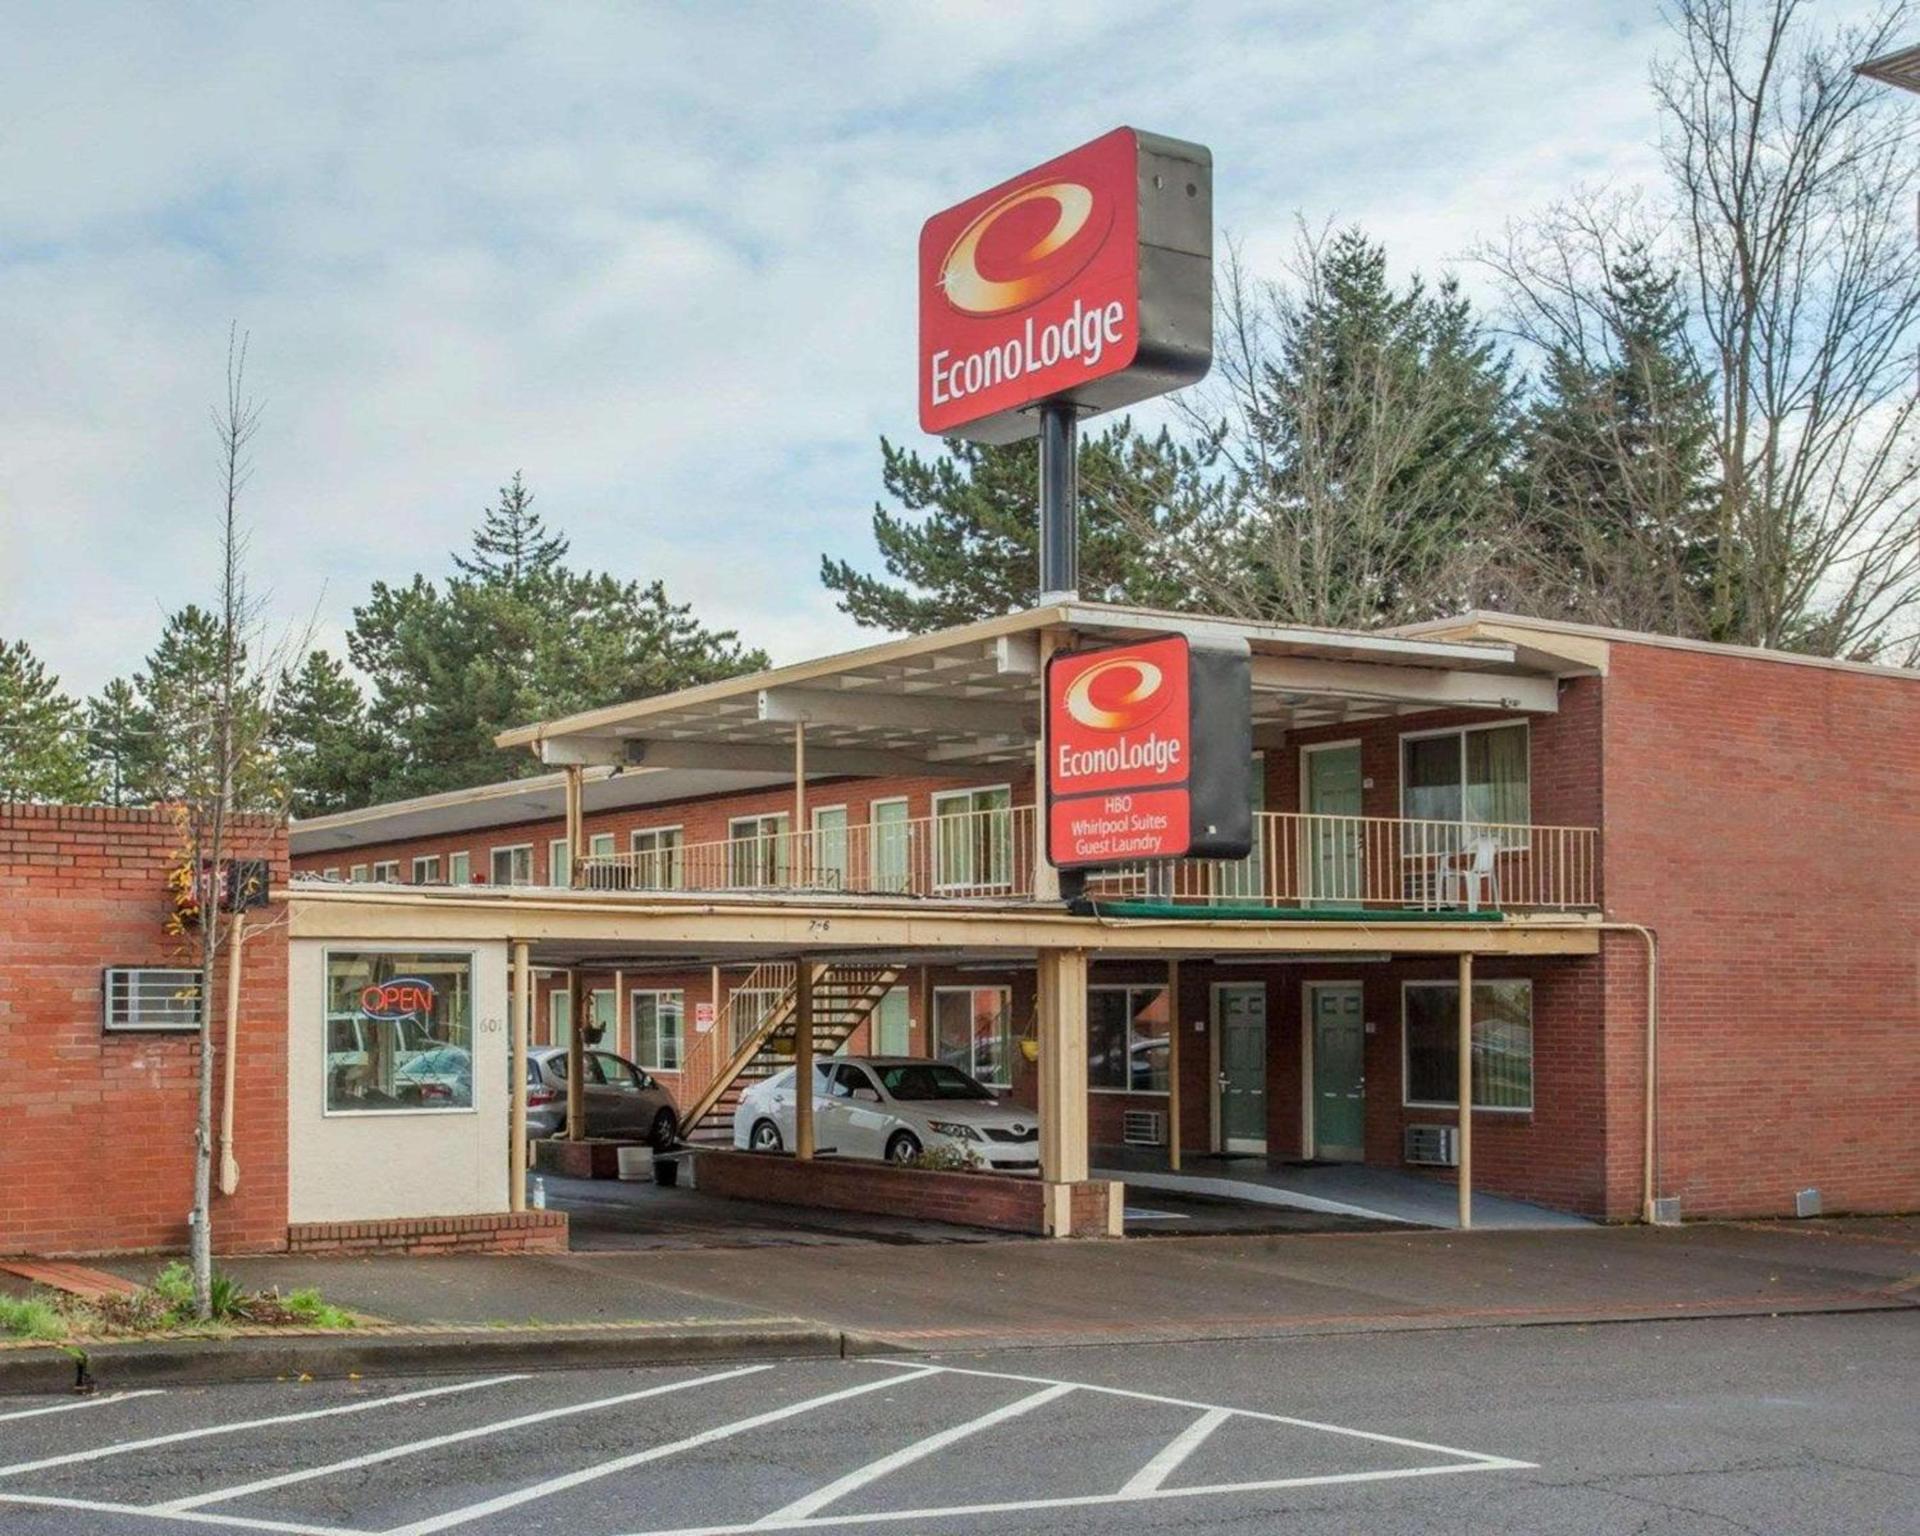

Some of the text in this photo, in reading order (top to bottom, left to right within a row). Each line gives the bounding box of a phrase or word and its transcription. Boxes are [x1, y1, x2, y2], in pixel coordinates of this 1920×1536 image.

[932, 299, 1123, 405] EconoLodge
[1059, 733, 1180, 777] EconoLodge
[1105, 796, 1131, 814] HBO
[1071, 814, 1167, 837] Whirlpool Suites
[1076, 834, 1162, 856] Guest Laundry
[362, 987, 432, 1011] OPEN
